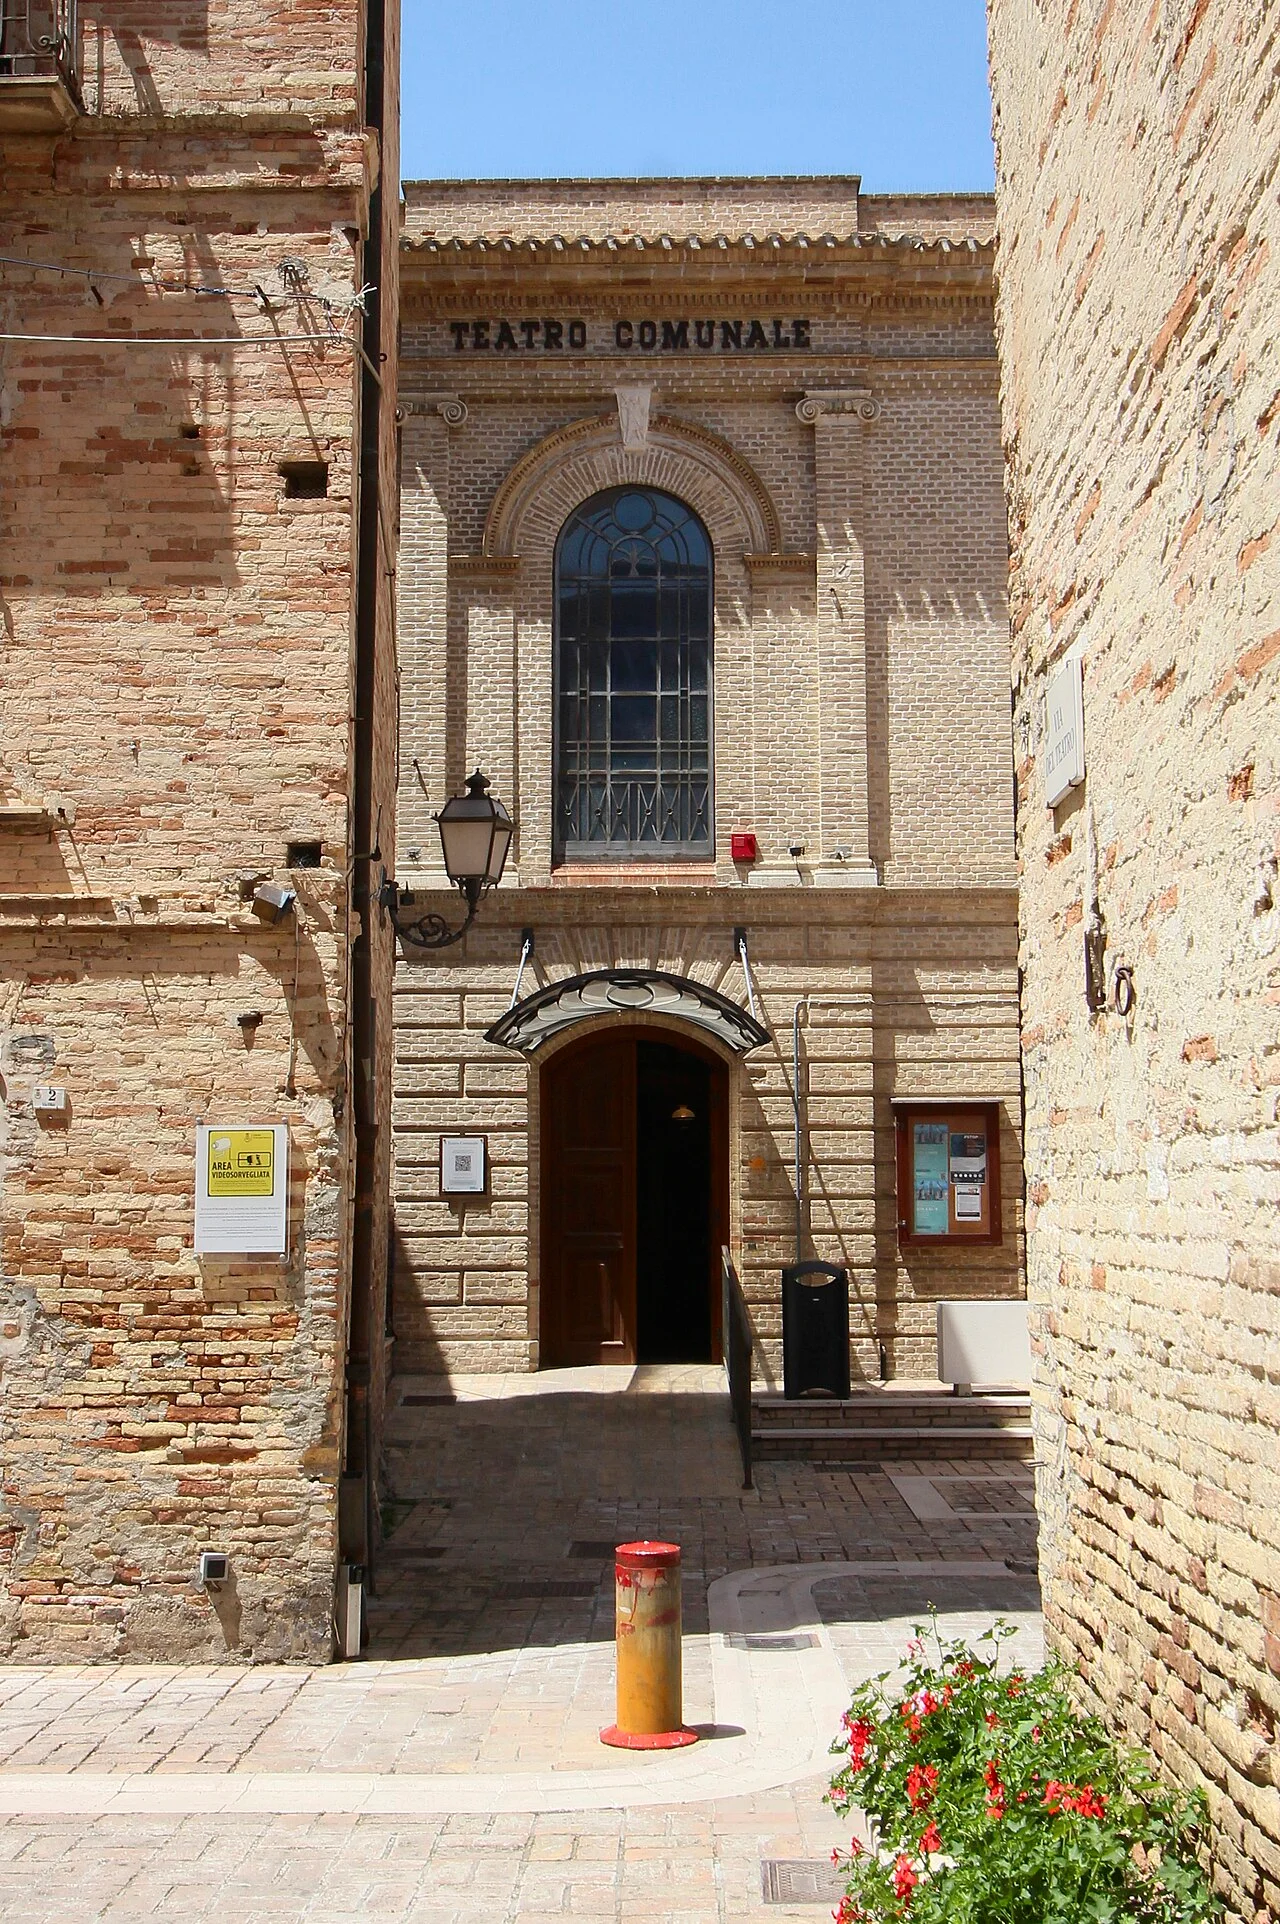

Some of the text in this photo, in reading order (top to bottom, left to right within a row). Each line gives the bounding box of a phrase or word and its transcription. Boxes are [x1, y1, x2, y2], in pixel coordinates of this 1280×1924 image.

[450, 319, 811, 350] TEATRO COMUNALE
[48, 1089, 56, 1101] 2
[212, 1161, 232, 1171] AREA
[211, 1171, 271, 1179] VIDEOSORVEGLIATA
